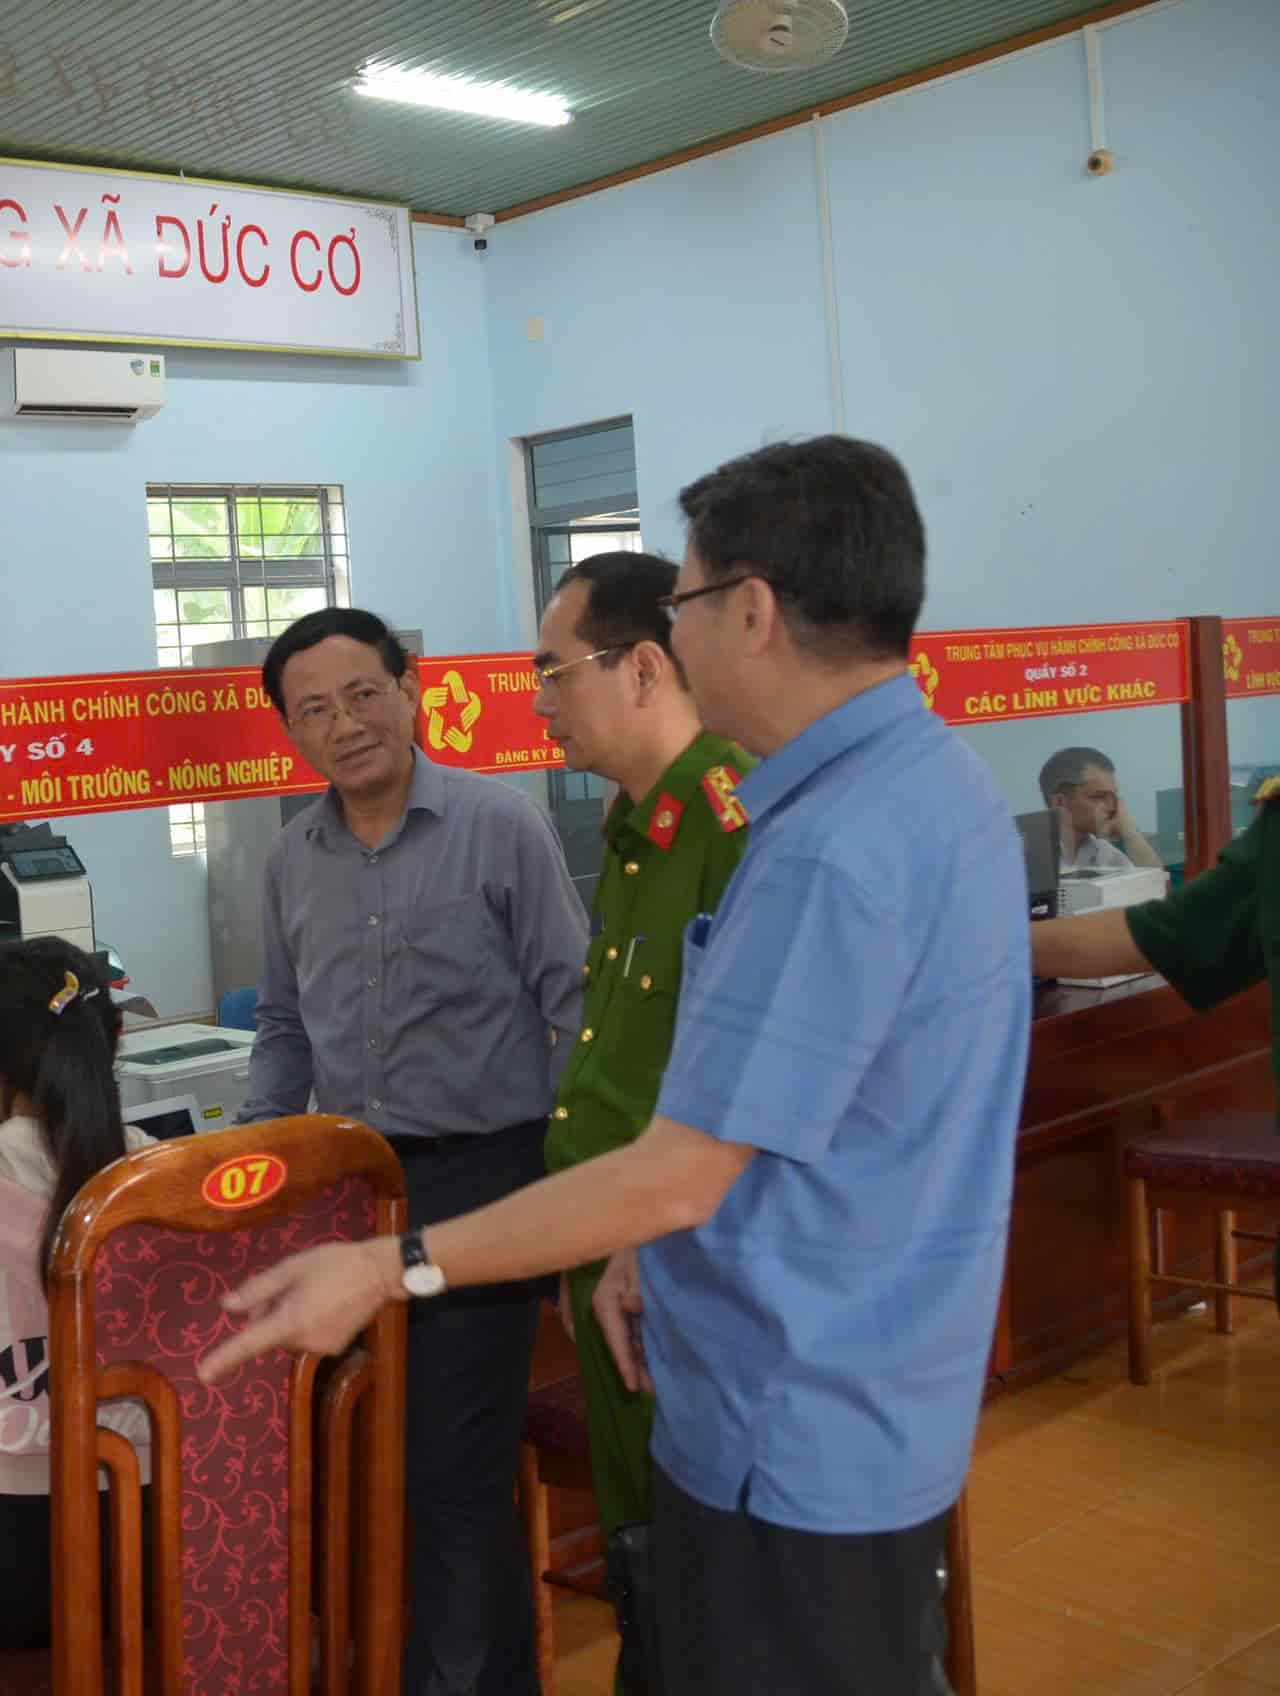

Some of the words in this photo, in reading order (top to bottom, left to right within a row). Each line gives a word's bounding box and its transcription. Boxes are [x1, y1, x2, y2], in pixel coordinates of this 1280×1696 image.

[53, 194, 133, 275] XÃ
[156, 204, 270, 287] ĐỨC
[290, 228, 361, 296] CƠ
[1080, 664, 1088, 677] 2
[1, 696, 65, 726] HÀNH
[72, 690, 139, 721] CHÍNH
[147, 686, 206, 716] CÔNG
[212, 684, 239, 711] XÃ
[965, 691, 1007, 714] CÁC
[1013, 687, 1058, 710] LĨNH
[1063, 683, 1102, 707] VỰC
[1108, 677, 1156, 700] KHÁC
[27, 732, 68, 761] SỐ
[76, 738, 94, 756] 4
[21, 771, 62, 806] MÔI
[67, 763, 151, 800] TRƯỜNG
[168, 758, 221, 791] NÔNG
[226, 752, 294, 787] NGHIỆP
[221, 1160, 269, 1200] 07
